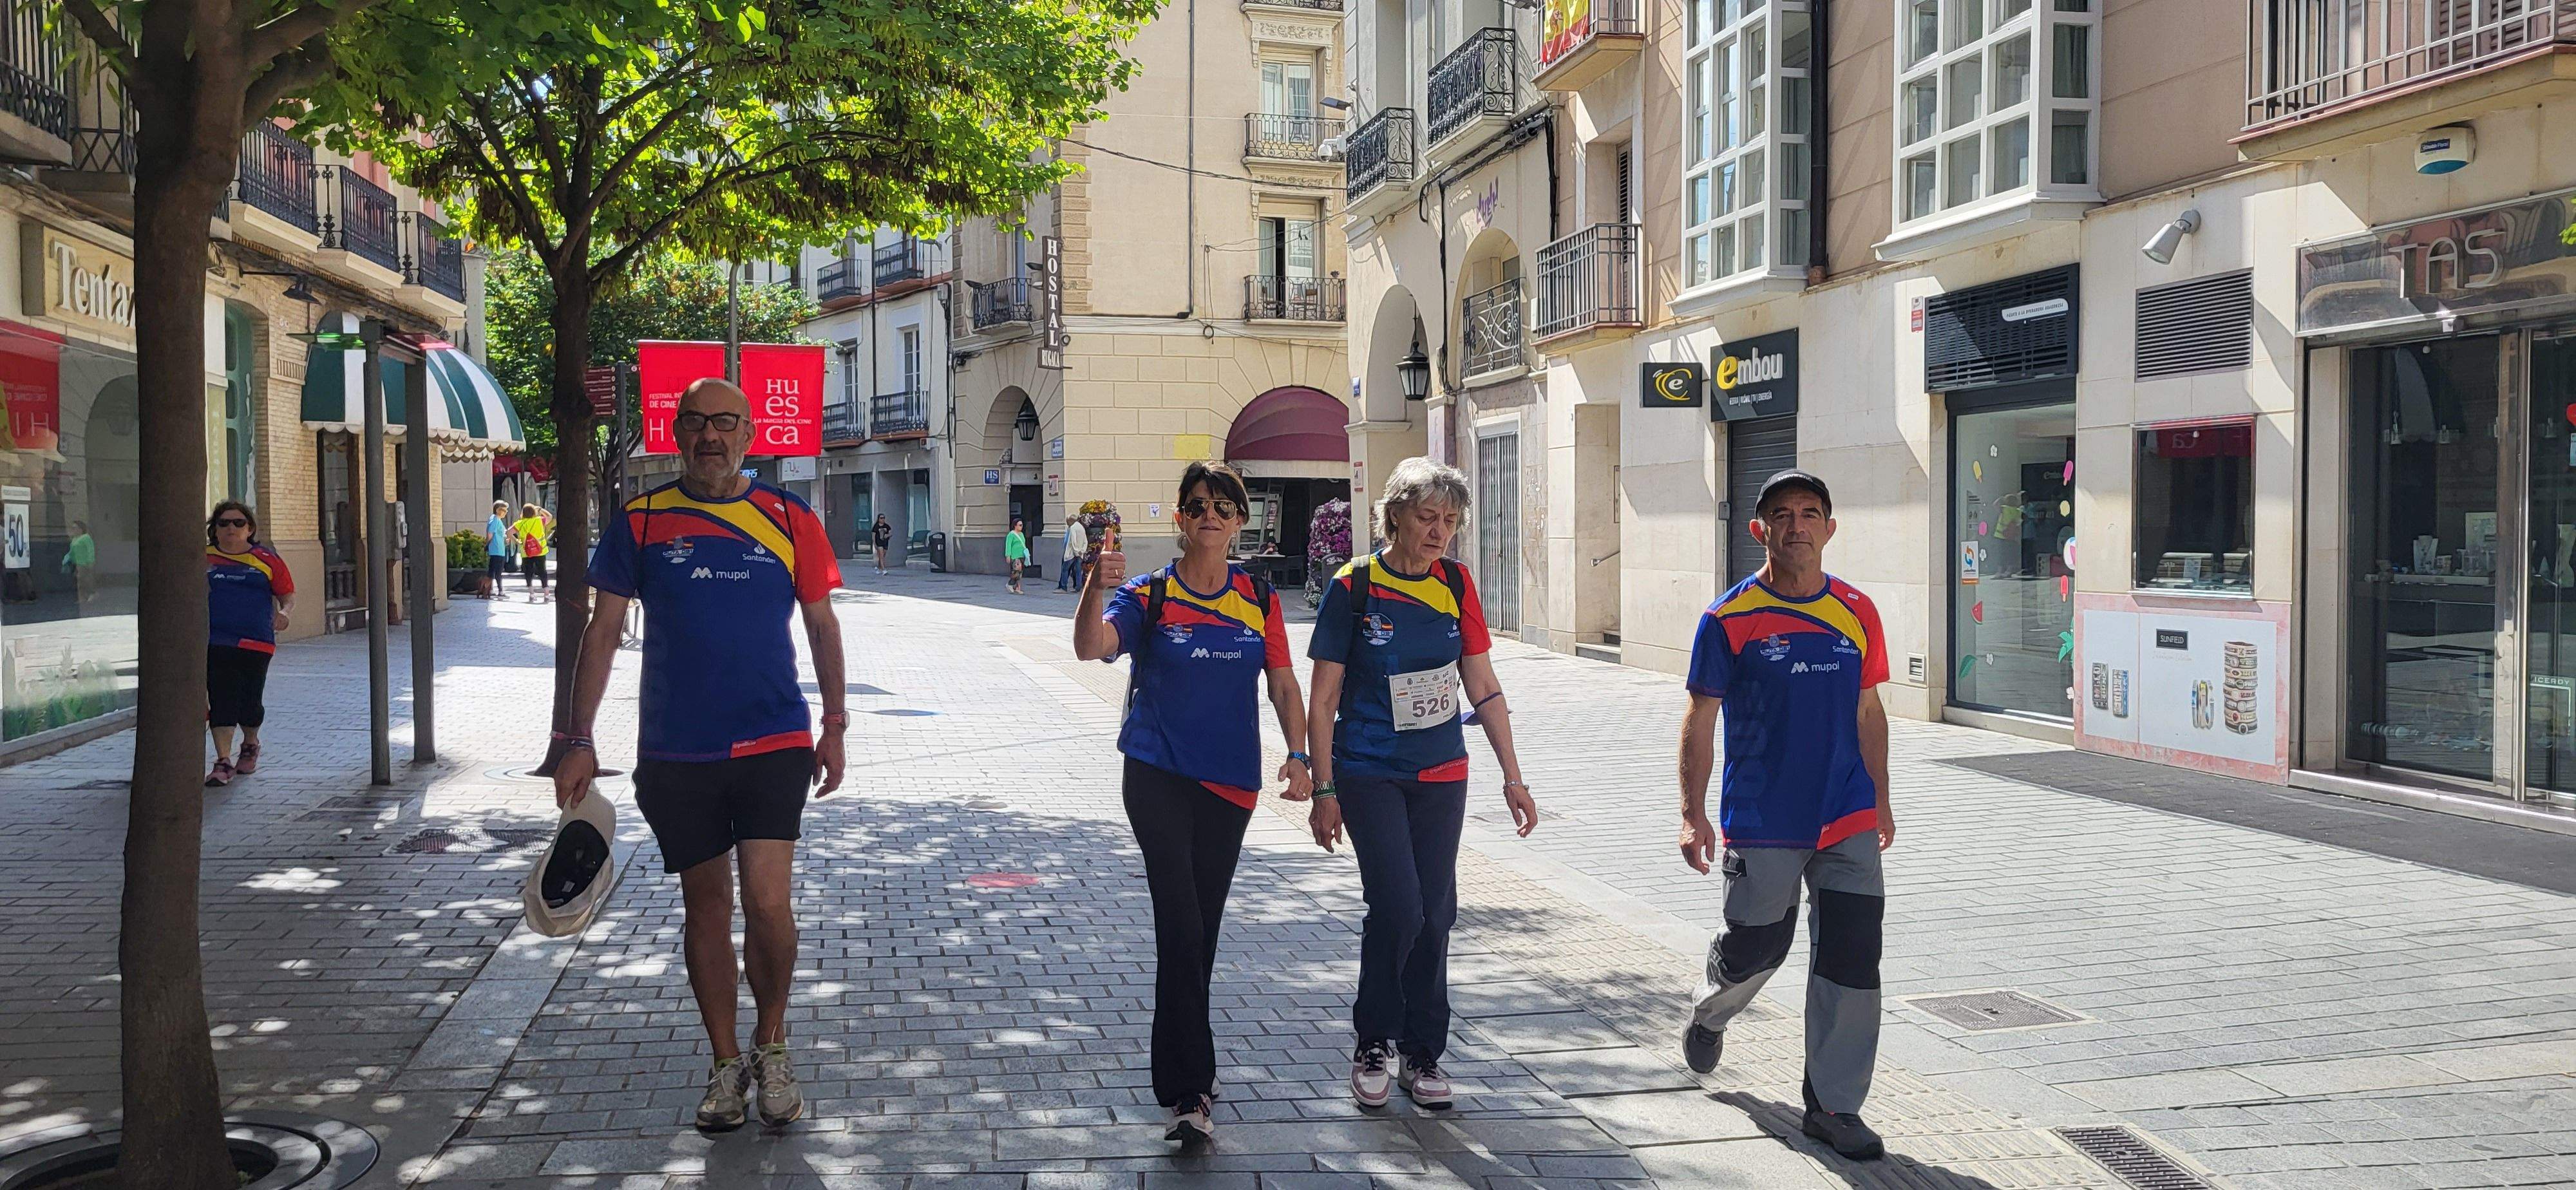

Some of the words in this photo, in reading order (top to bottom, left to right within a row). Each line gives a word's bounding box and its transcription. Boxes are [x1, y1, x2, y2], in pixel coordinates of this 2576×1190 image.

[2389, 228, 2503, 298] TAS
[1047, 239, 1059, 346] HOSTAL
[1041, 350, 1060, 366] RUGACA
[1717, 347, 1783, 390] embou
[986, 471, 998, 479] HS
[743, 553, 776, 564] Santander
[716, 569, 750, 581] mupol
[1213, 650, 1242, 660] mupol
[1812, 661, 1840, 672] mupol
[2533, 676, 2570, 686] ICEROY
[1412, 693, 1450, 718] 526
